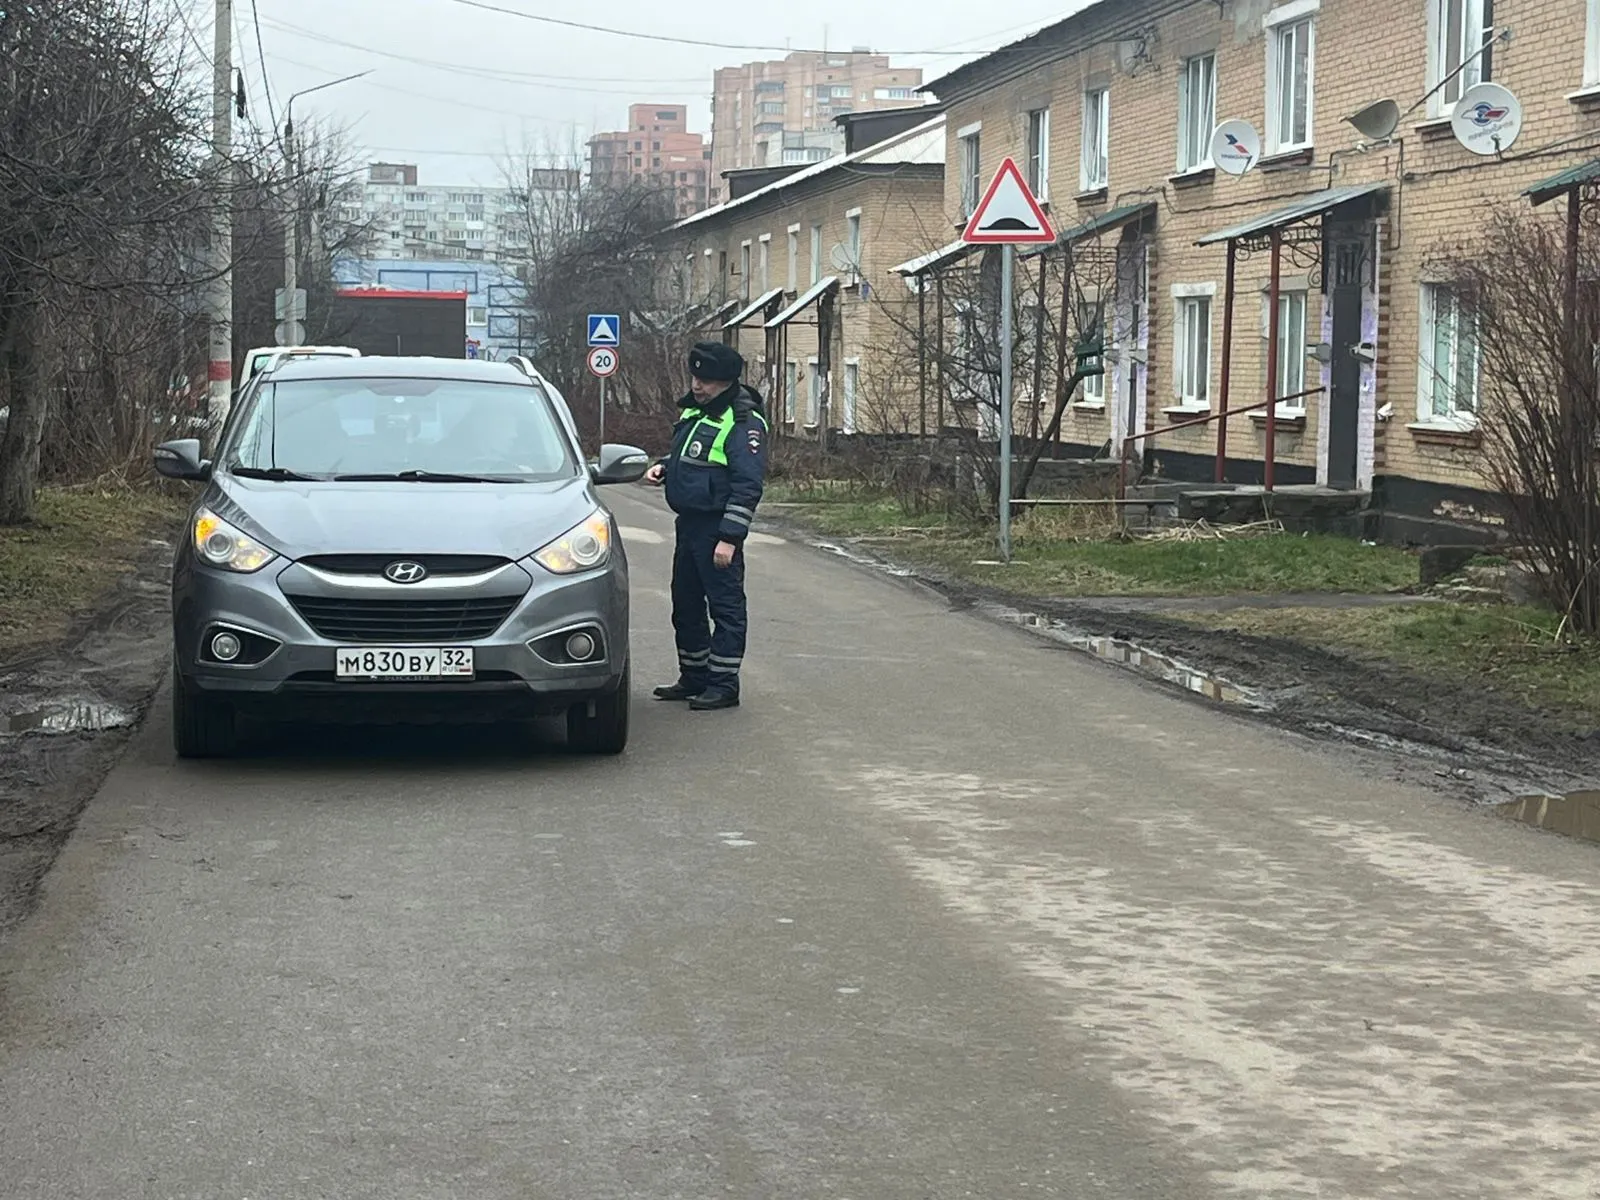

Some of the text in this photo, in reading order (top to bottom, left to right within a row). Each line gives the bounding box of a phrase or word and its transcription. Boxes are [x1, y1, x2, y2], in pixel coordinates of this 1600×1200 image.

[596, 355, 611, 367] 20
[345, 650, 465, 673] М830ВУ 32
